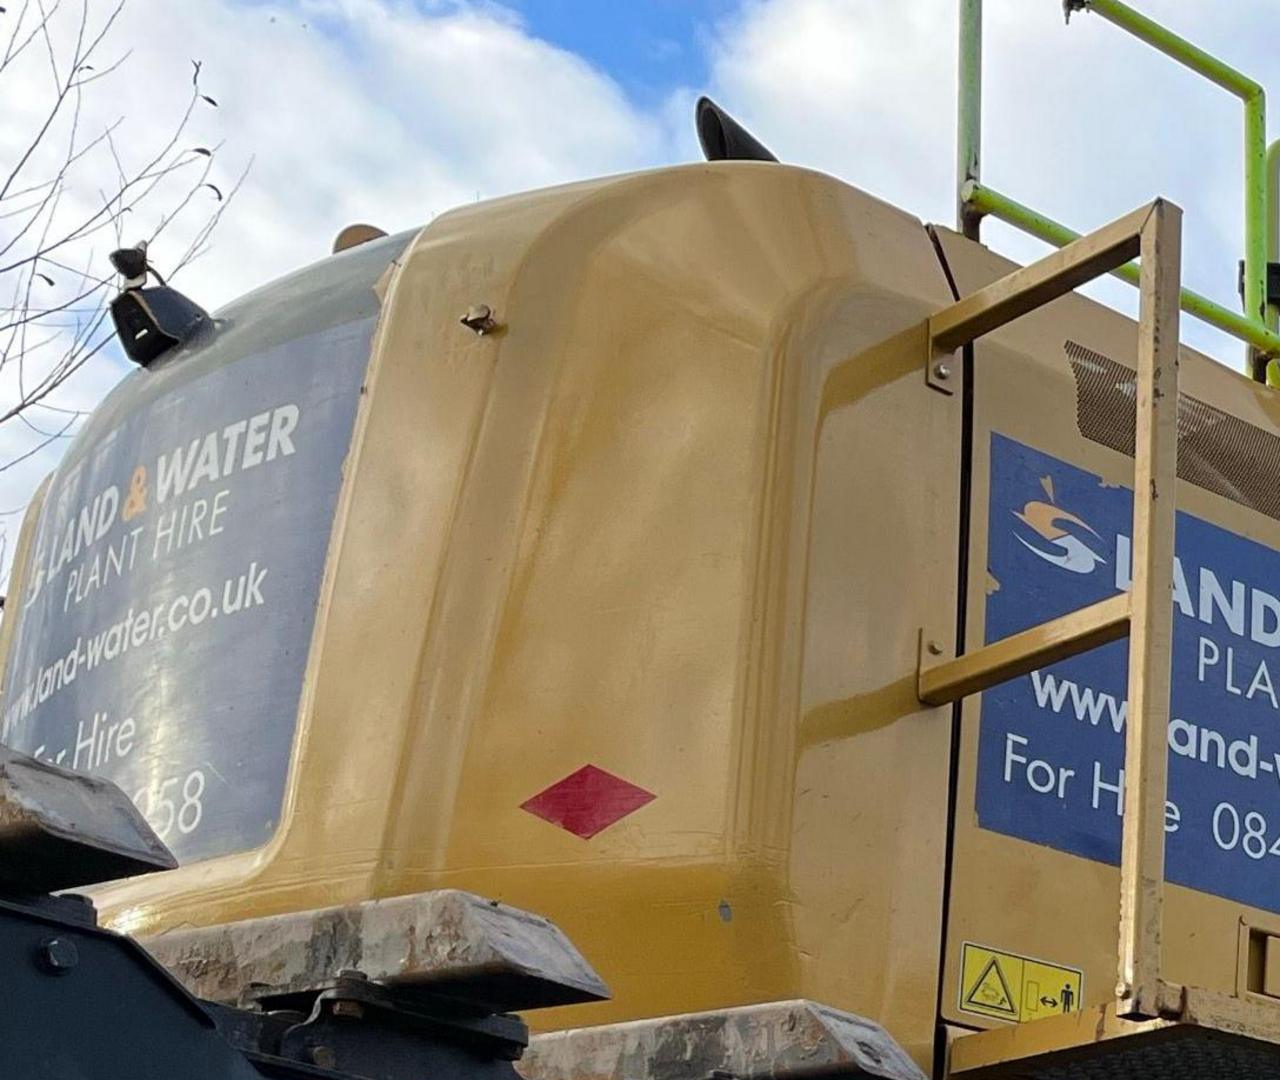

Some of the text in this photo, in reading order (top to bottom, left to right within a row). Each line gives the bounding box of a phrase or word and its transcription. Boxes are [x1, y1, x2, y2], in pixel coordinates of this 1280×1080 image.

[47, 404, 300, 584] LAND & WATER
[64, 490, 230, 613] PLANT HIRE
[72, 711, 136, 770] Hire
[1004, 732, 1075, 799] For
[1092, 760, 1182, 833] He
